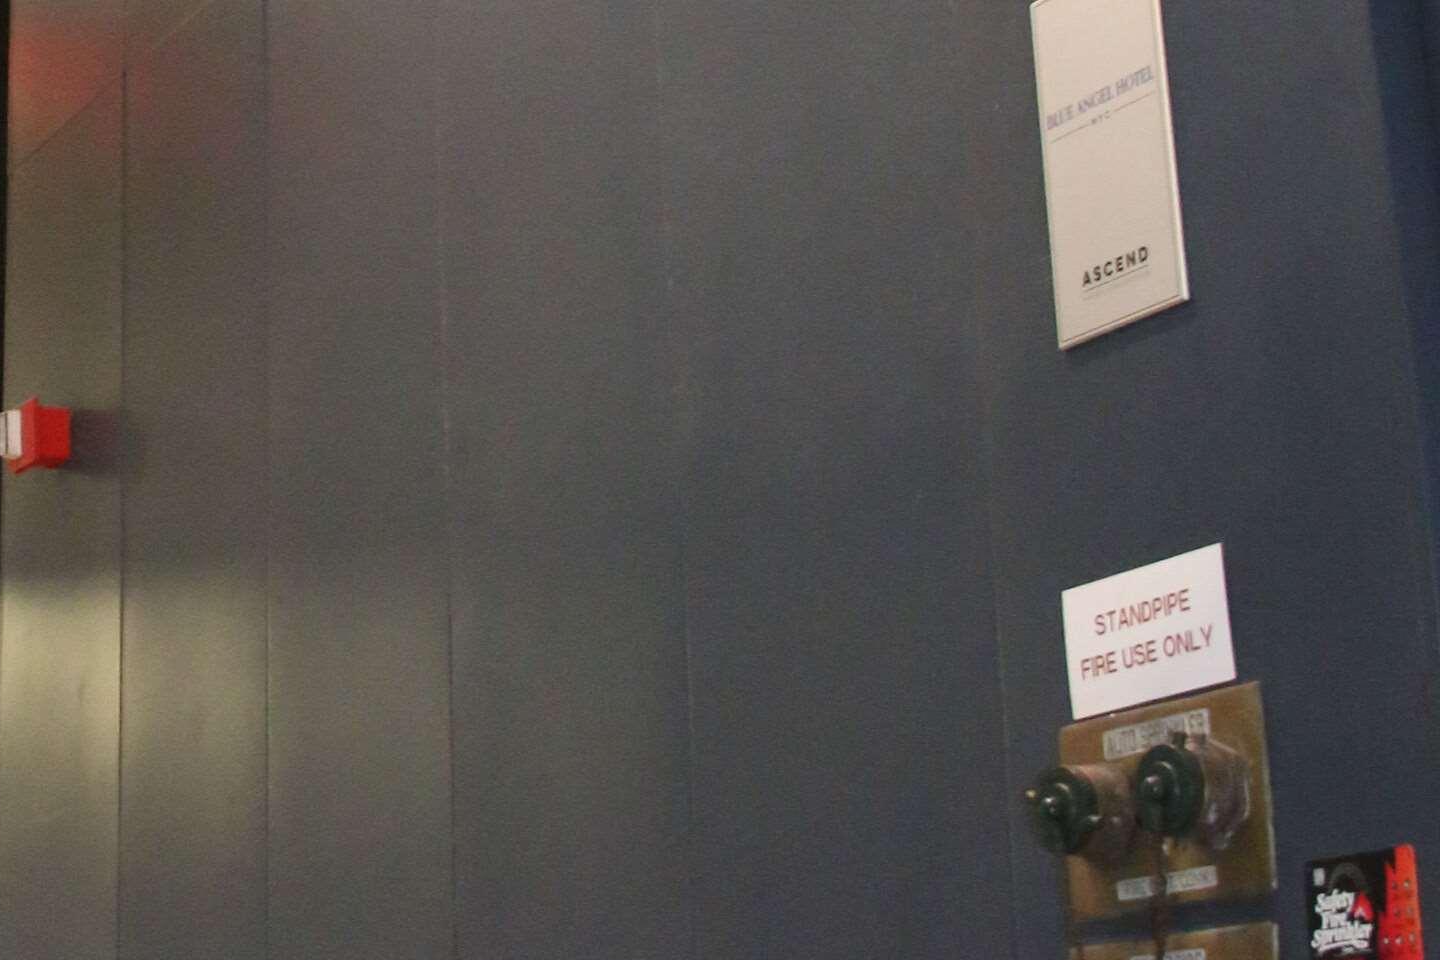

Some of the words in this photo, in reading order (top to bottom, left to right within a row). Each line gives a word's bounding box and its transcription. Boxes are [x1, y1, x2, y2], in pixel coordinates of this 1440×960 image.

[1046, 104, 1074, 130] BLUE
[1078, 86, 1114, 113] ANGEL
[1116, 65, 1154, 96] HOTEL
[1082, 246, 1149, 287] ASCEND
[1095, 588, 1191, 635] STANDPIPE
[1081, 651, 1118, 680] FIRE
[1121, 640, 1158, 668] USE
[1163, 624, 1213, 657] ONLY
